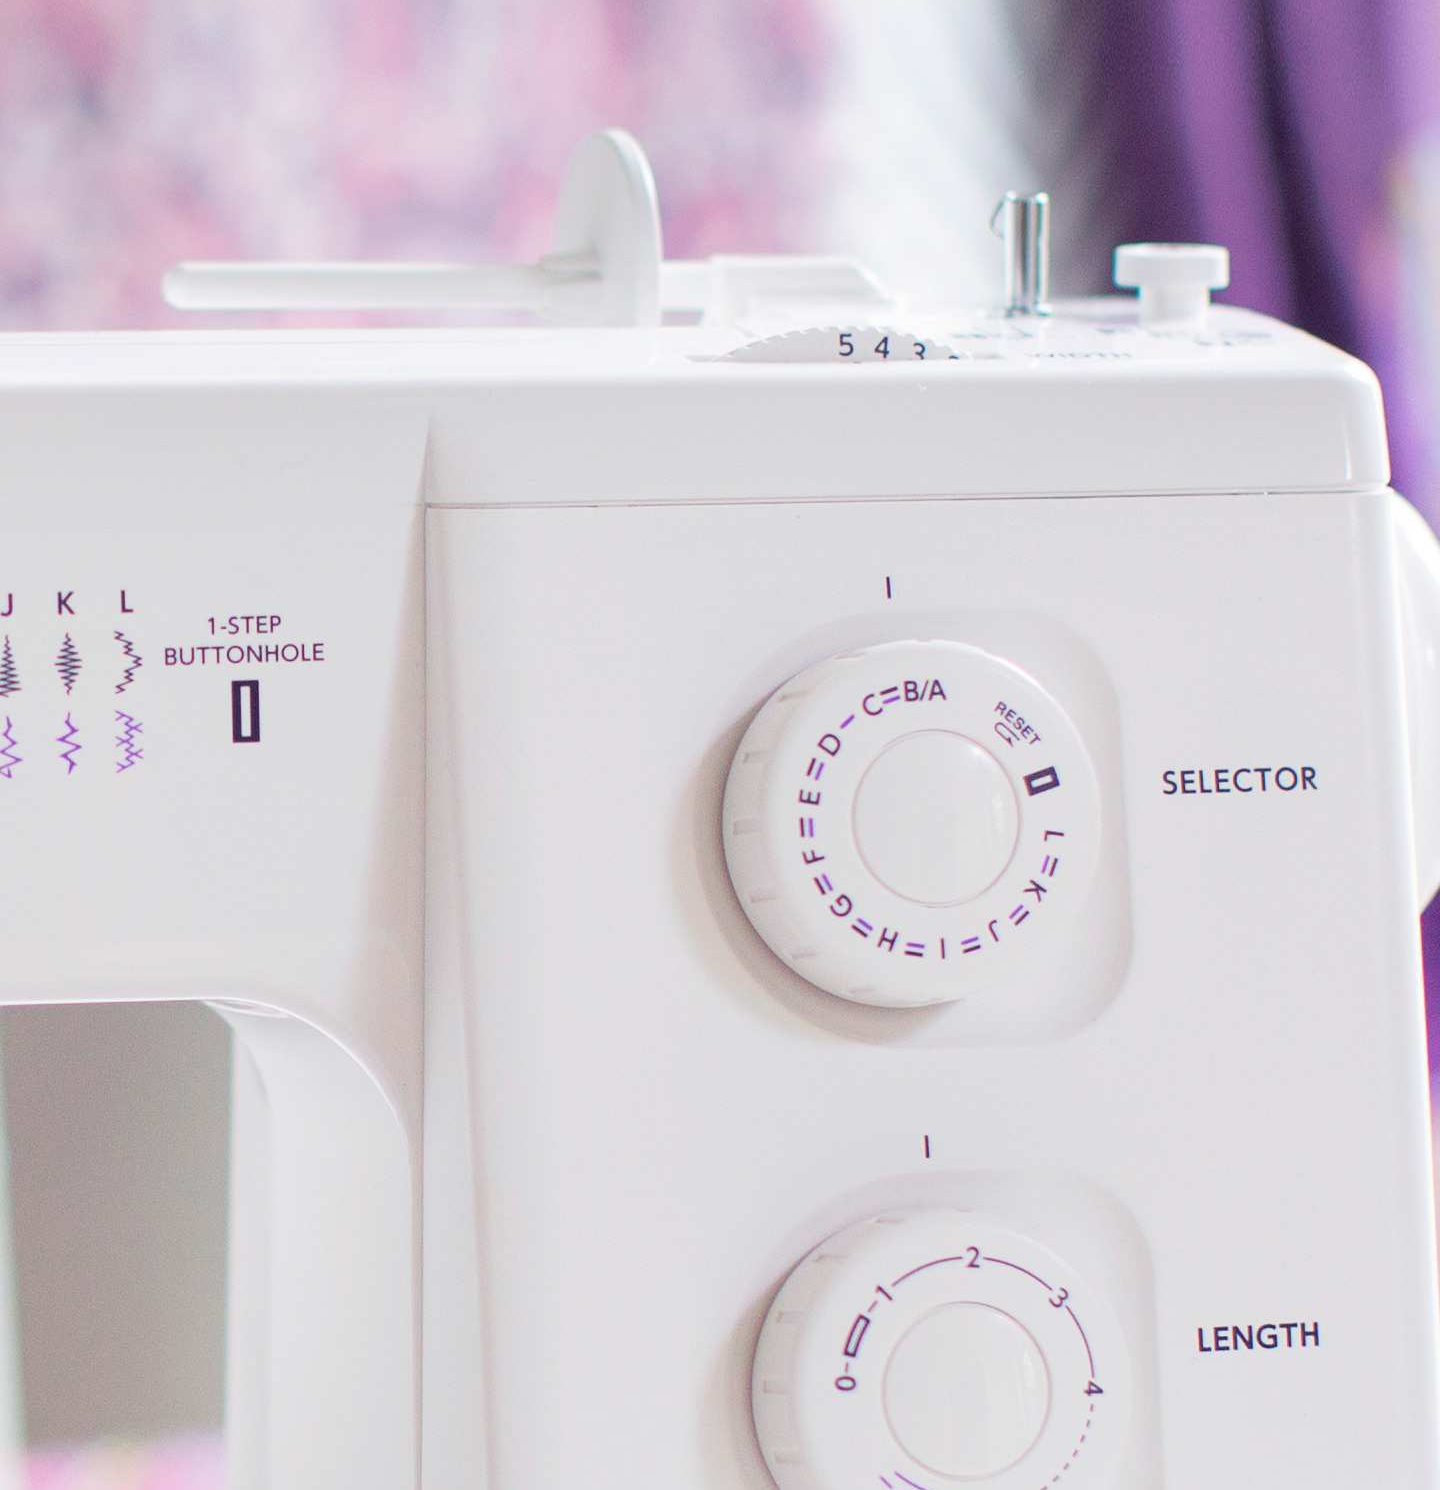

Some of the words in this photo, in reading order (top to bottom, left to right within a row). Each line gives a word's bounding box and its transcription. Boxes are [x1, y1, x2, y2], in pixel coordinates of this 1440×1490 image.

[838, 333, 854, 357] 5
[874, 336, 890, 359] 4
[0, 593, 13, 617] J
[57, 591, 75, 615] K
[120, 590, 133, 613] L
[207, 615, 282, 635] 1-STEP
[164, 643, 325, 666] BUTTONHOLE
[994, 701, 1041, 745] RESET
[1161, 766, 1318, 795] SELECTOR
[875, 1285, 893, 1301] 1
[966, 1246, 980, 1268] 2
[1048, 1287, 1069, 1308] 3
[1083, 1380, 1104, 1396] 4
[1197, 1322, 1320, 1353] LENGTH
